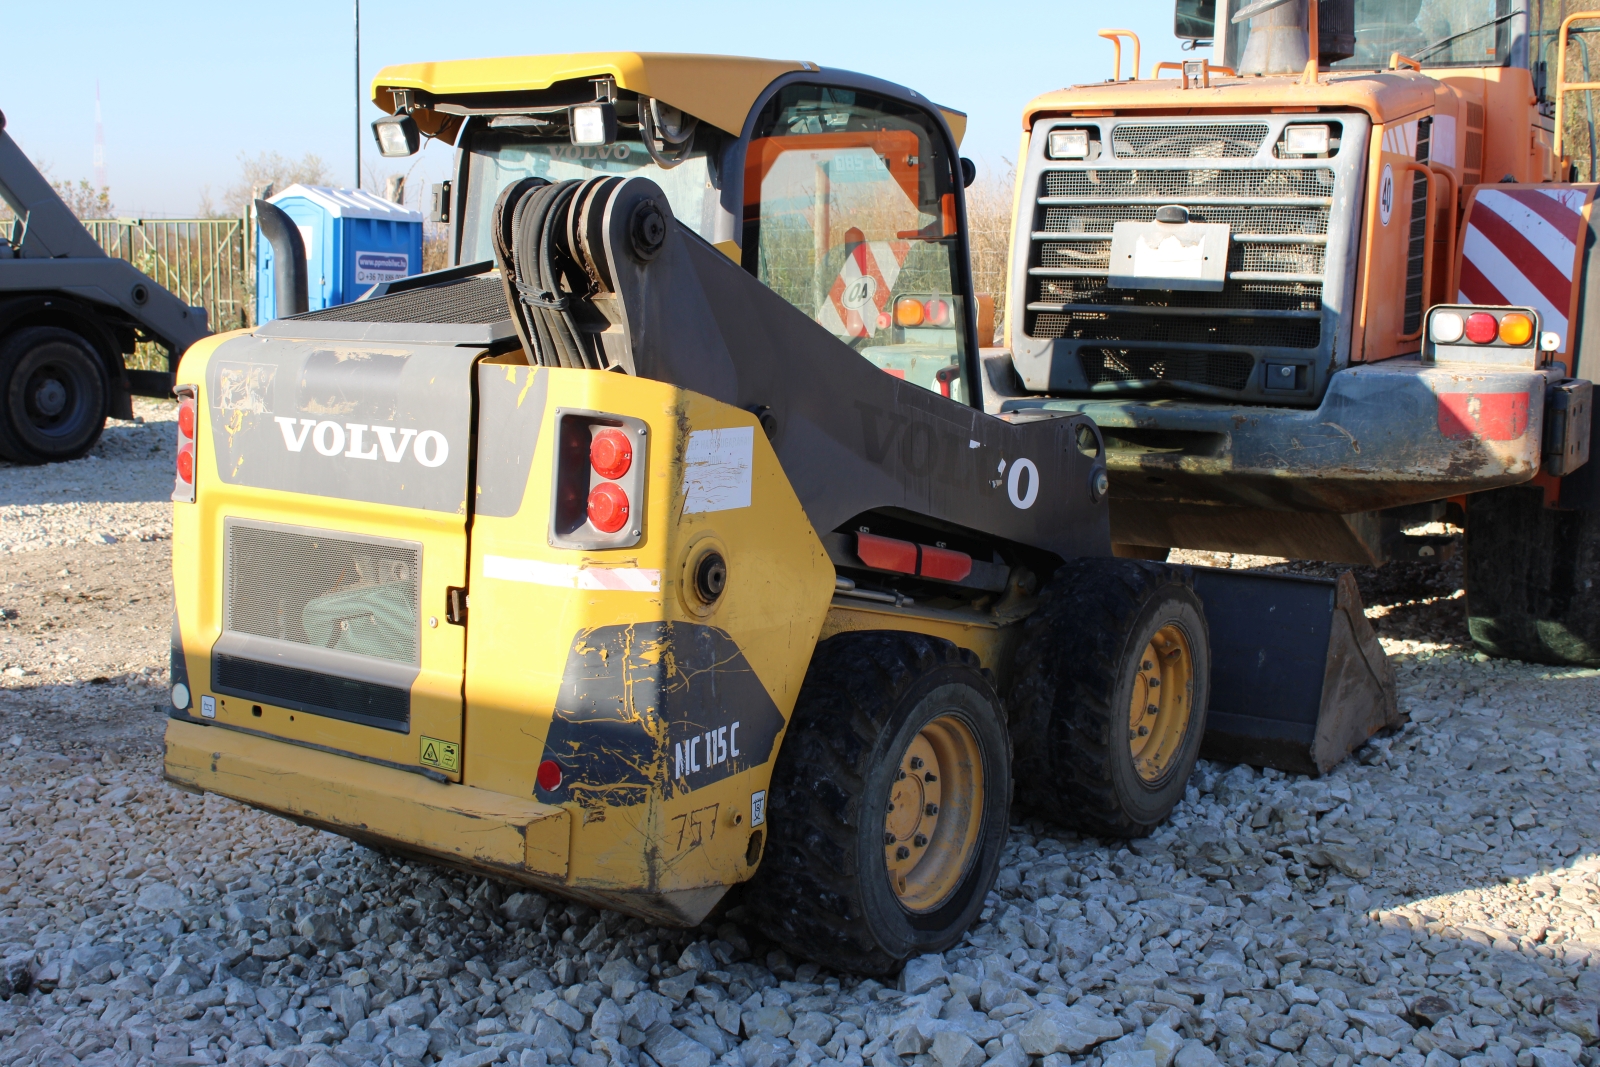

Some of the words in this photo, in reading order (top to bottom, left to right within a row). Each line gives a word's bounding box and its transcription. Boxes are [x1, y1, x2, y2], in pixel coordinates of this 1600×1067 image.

[547, 144, 630, 160] VOLVO
[1382, 177, 1392, 213] 40
[274, 416, 449, 468] VOLVO
[705, 726, 727, 768] 115
[730, 721, 740, 758] C
